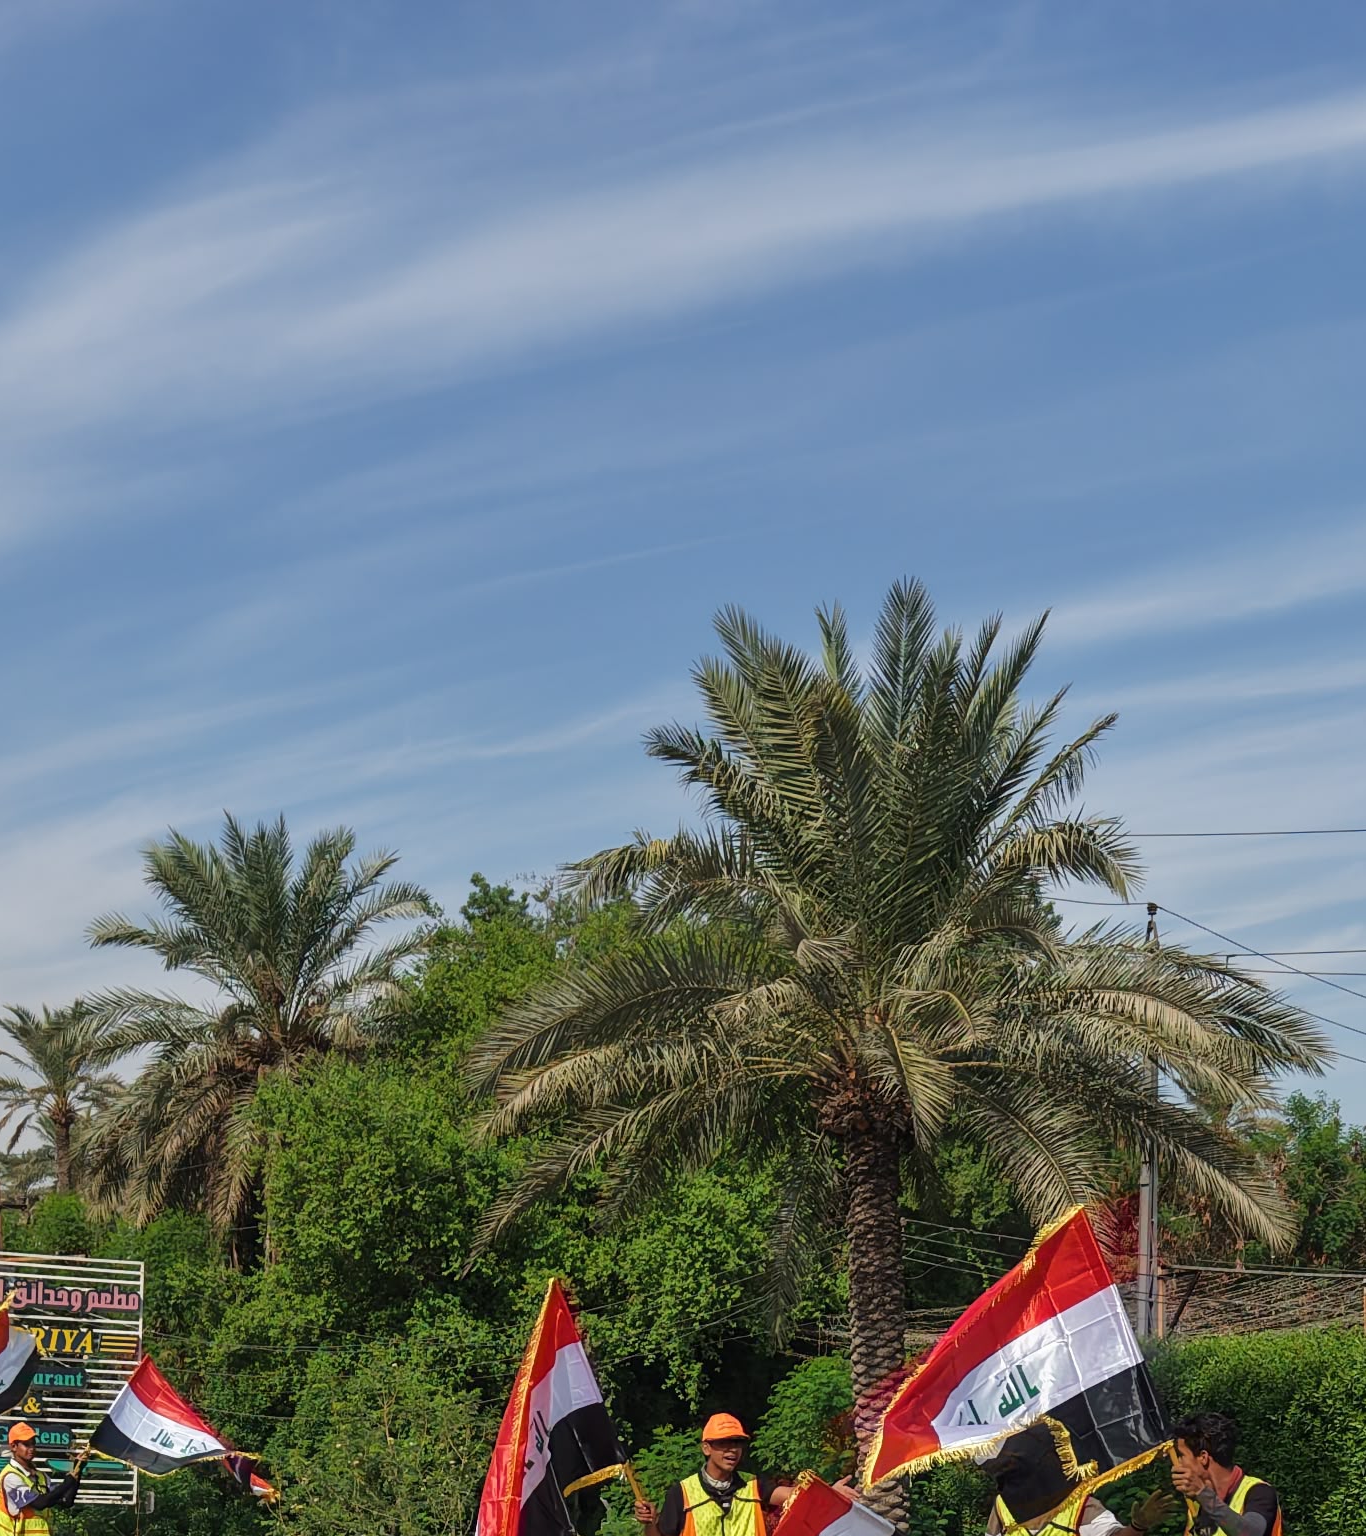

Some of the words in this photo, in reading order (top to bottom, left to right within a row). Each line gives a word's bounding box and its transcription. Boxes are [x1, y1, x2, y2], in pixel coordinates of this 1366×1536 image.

[86, 1285, 140, 1312] مطعم
[30, 1326, 94, 1355] RIYA
[33, 1371, 84, 1388] urant
[997, 1363, 1041, 1419] الله
[22, 1396, 41, 1415] &
